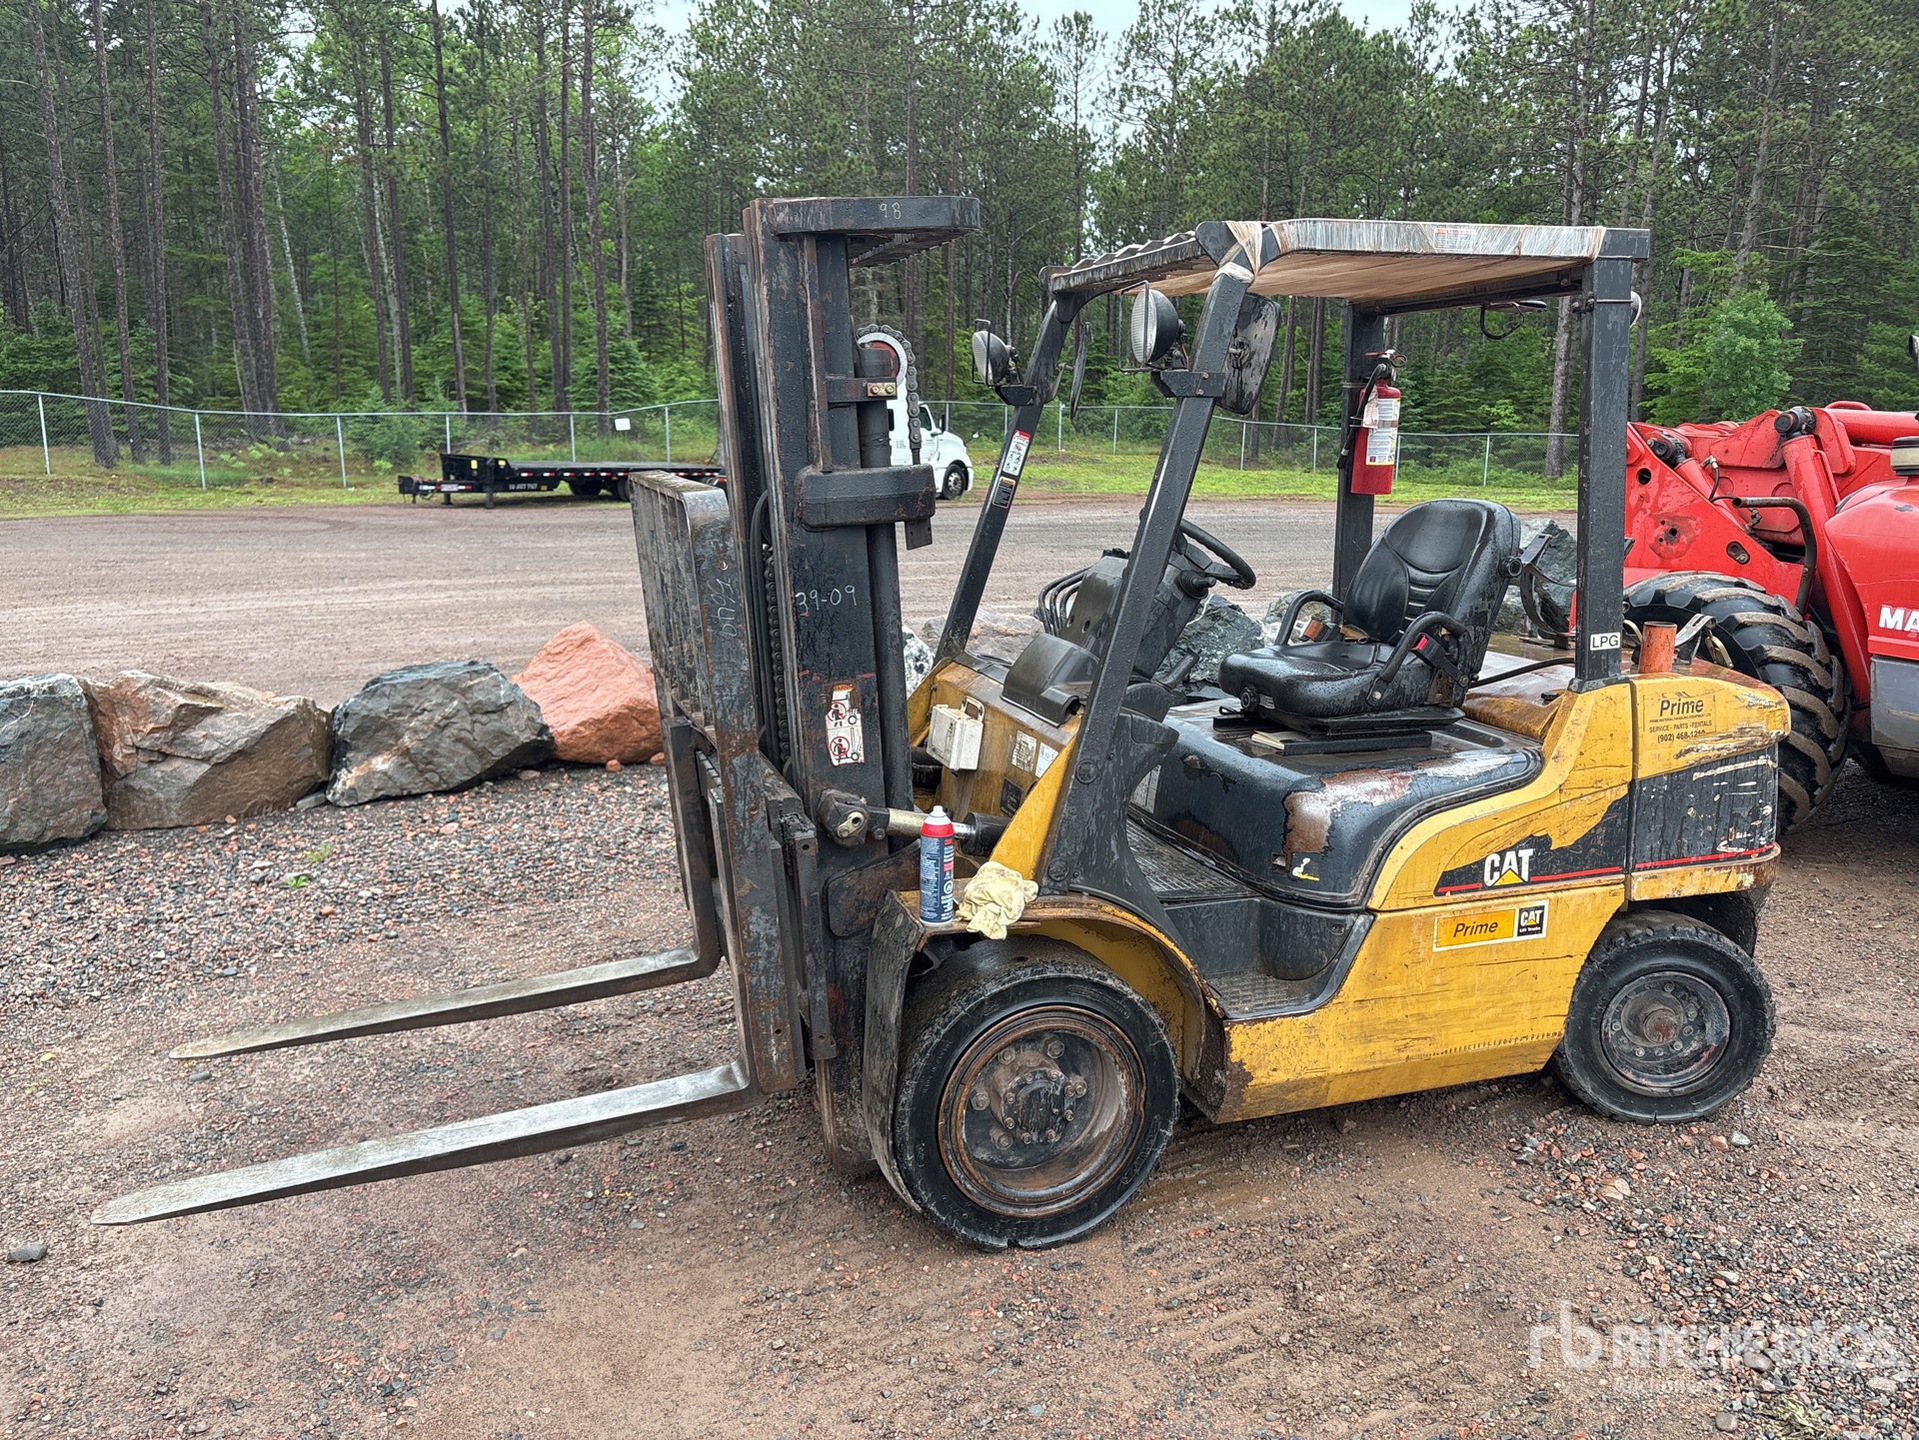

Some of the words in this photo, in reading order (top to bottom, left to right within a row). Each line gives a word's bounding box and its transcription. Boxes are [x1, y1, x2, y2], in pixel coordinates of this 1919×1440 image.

[880, 202, 901, 219] 98
[795, 585, 857, 613] 39-09
[1592, 635, 1619, 648] LPG
[1660, 699, 1704, 716] Prime
[1649, 725, 1669, 733] SERVICE
[1657, 733, 1674, 743] (902)
[1484, 848, 1534, 887] CAT
[1520, 909, 1543, 927] CAT
[1453, 921, 1498, 937] Prime
